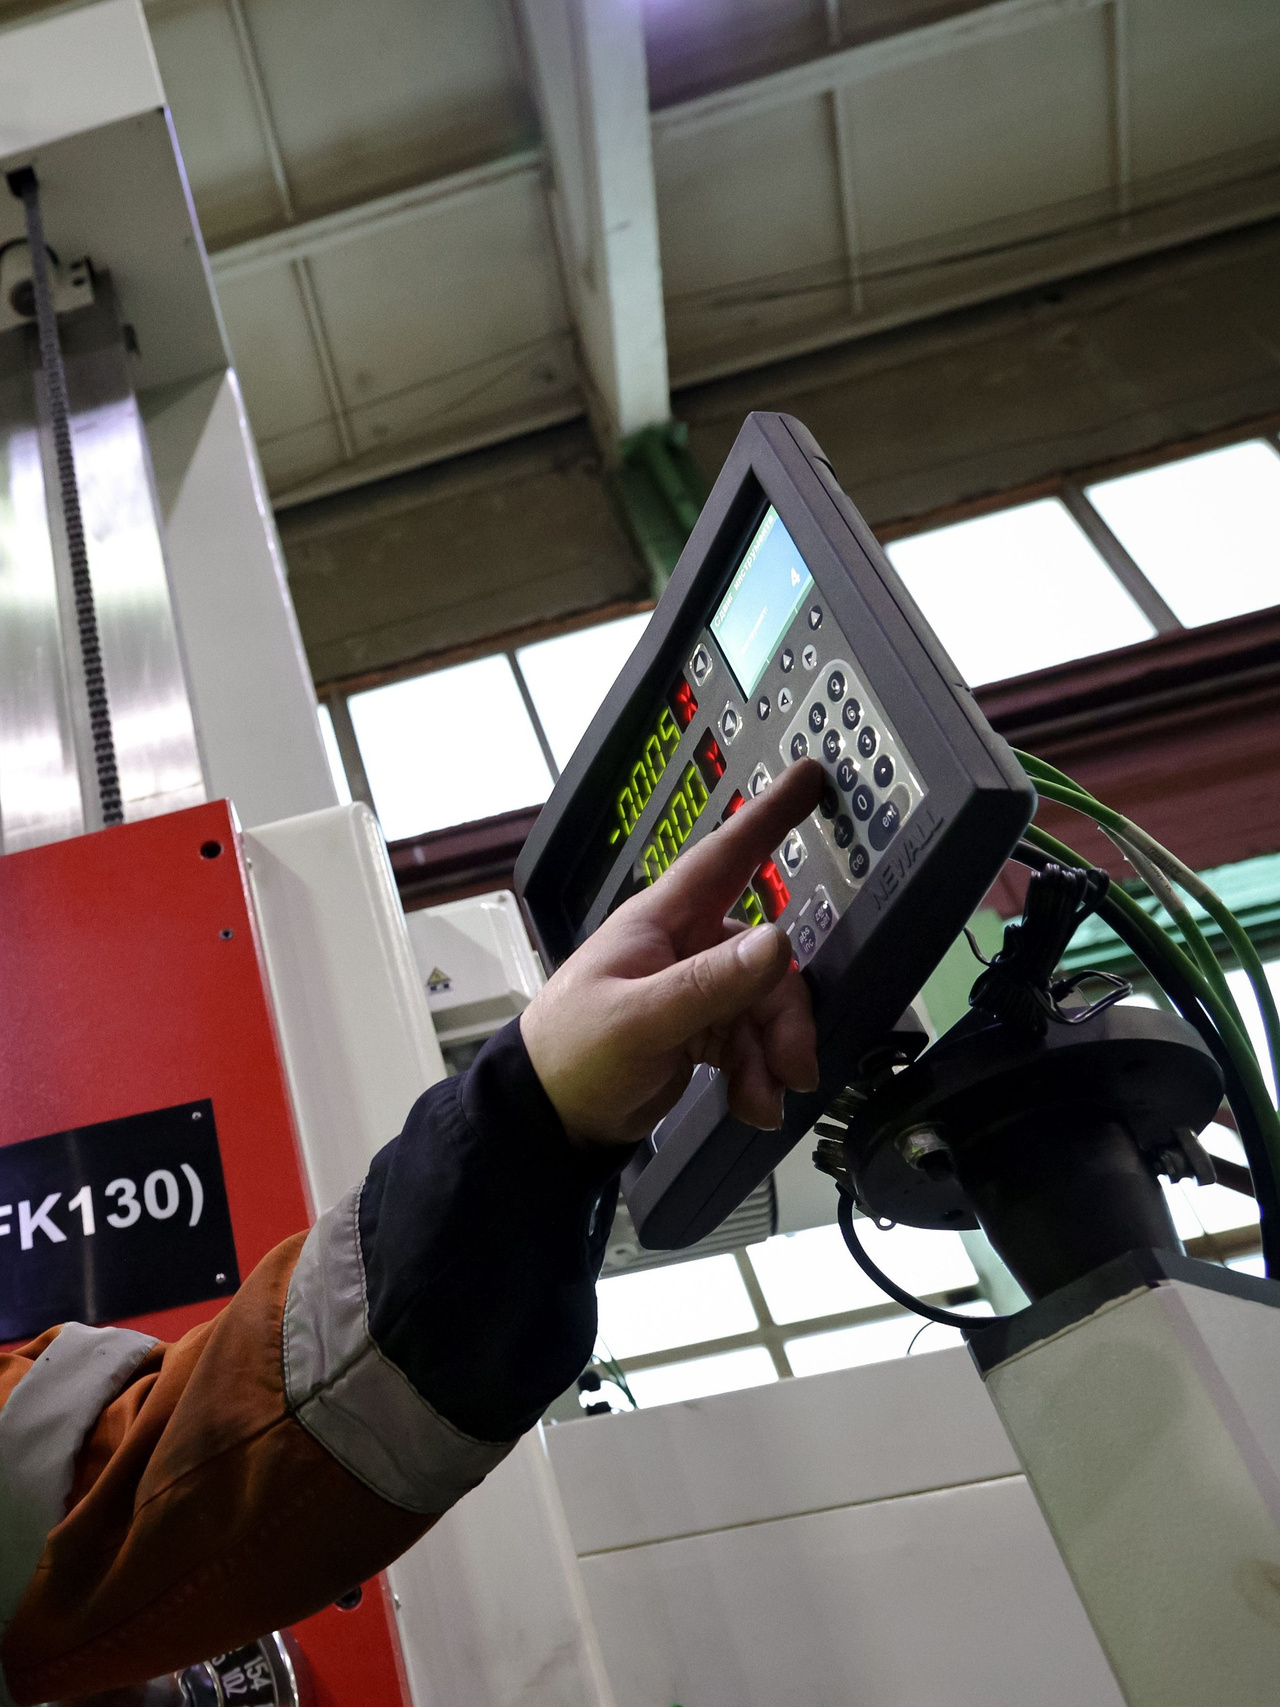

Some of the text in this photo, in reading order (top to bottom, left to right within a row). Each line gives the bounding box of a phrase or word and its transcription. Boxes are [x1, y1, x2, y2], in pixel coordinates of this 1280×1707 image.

[714, 594, 734, 628] Сдвиг
[733, 514, 775, 592] инструмента
[790, 567, 801, 588] 4
[676, 679, 698, 723] X
[793, 678, 841, 756] 7 8 9
[826, 705, 856, 753] 5 6
[706, 739, 724, 778] Y
[841, 765, 853, 783] 2
[861, 734, 872, 751] 3
[857, 793, 868, 811] 0
[852, 804, 897, 871] ce ent
[869, 808, 945, 912] NEWALL
